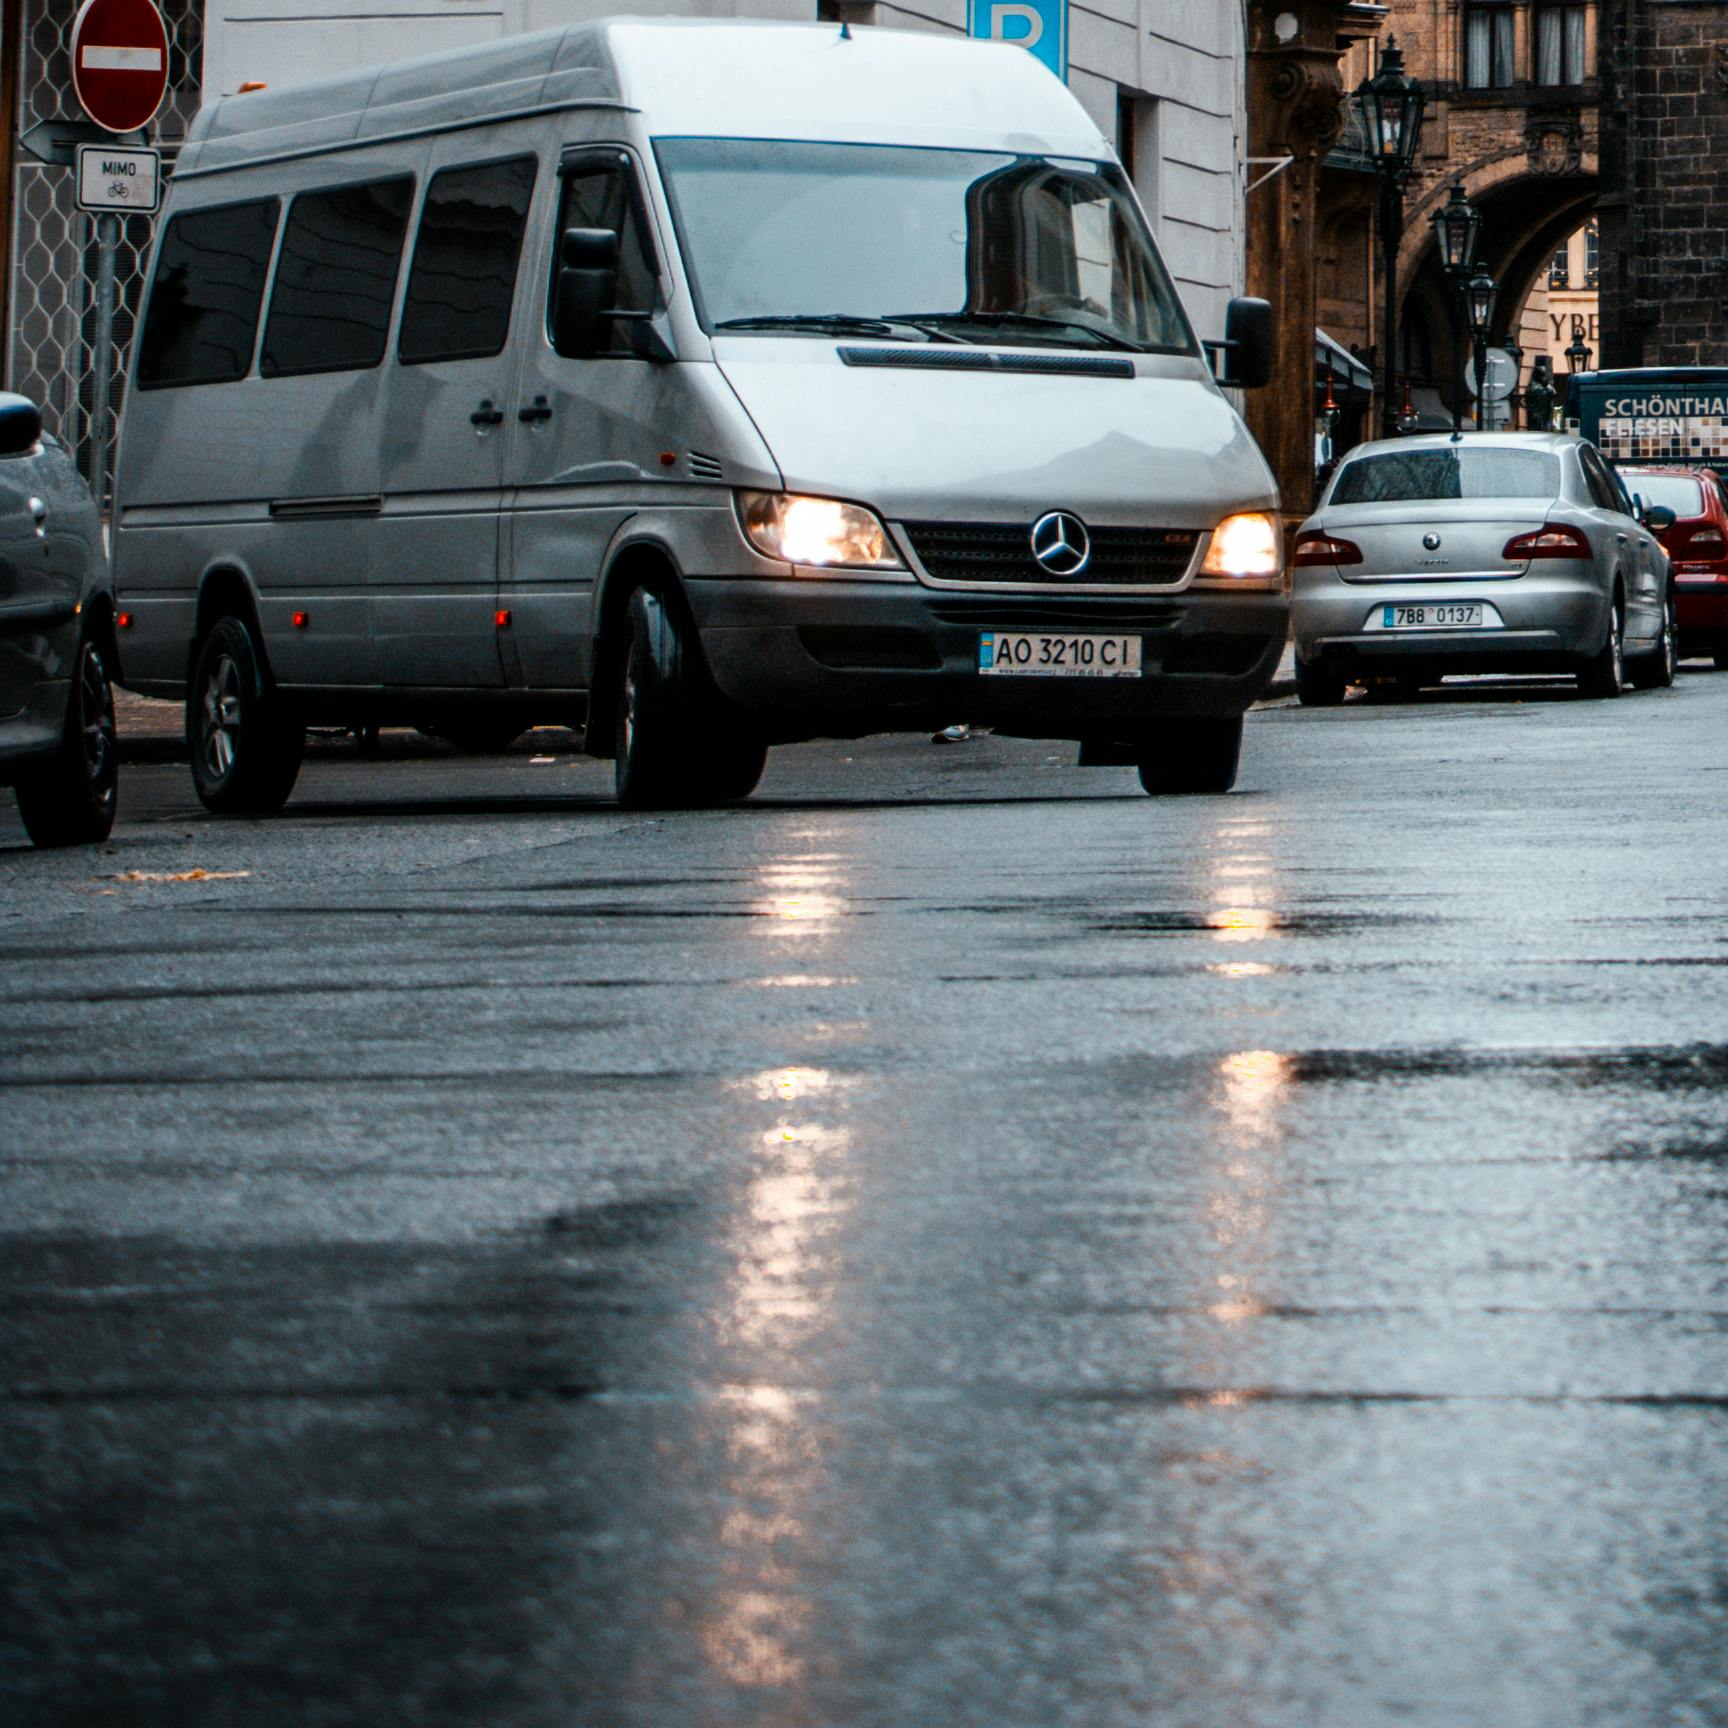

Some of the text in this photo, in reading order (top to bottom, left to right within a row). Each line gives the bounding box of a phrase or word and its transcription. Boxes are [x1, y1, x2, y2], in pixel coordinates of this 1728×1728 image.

[991, 4, 1043, 49] P
[103, 161, 136, 176] MIMO
[1605, 418, 1684, 436] FLIESEN
[1397, 608, 1474, 624] 7B8 0137
[996, 638, 1128, 666] AO 3210 CI
